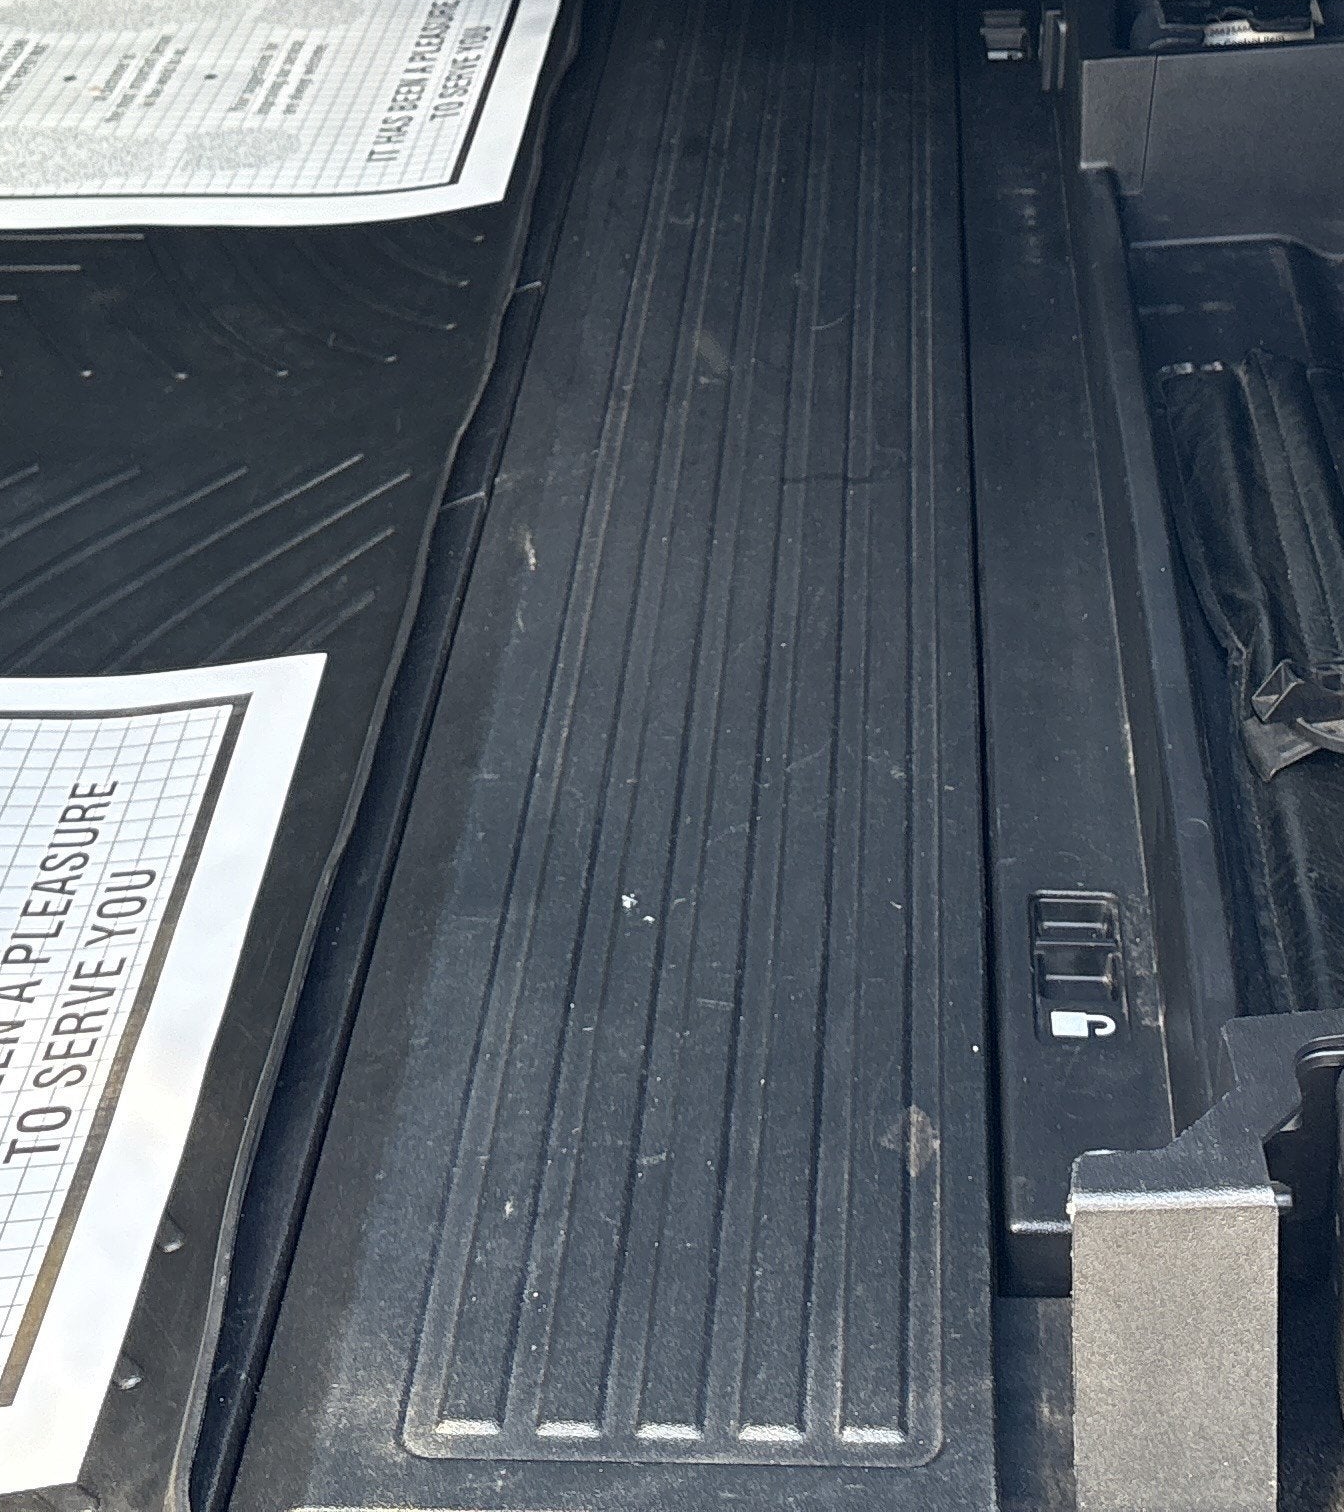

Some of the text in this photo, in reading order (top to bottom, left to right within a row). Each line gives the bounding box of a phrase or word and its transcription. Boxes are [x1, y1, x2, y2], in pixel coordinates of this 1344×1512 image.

[366, 0, 461, 162] IT HAS BEEN A PLEASURE
[429, 25, 492, 121] TO SERVE YOU
[1, 779, 120, 968] PLEASURE
[2, 868, 158, 1164] TO SERVE YOU
